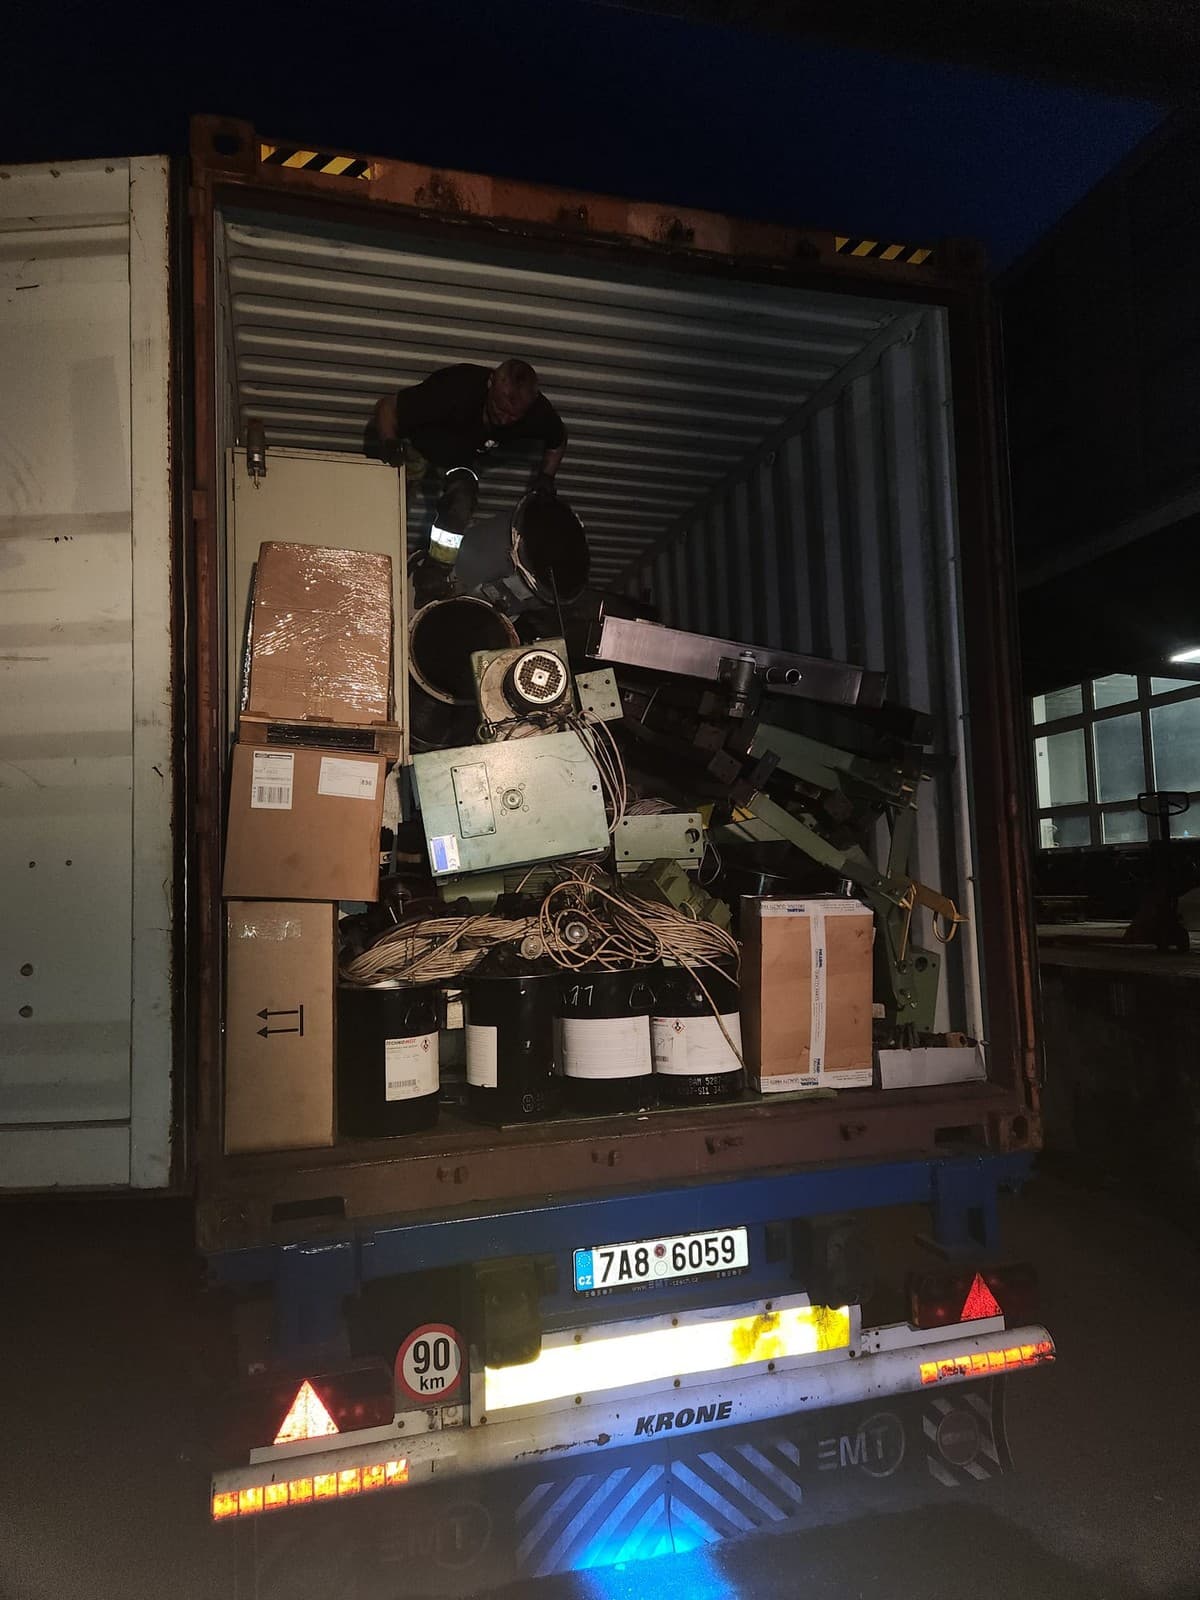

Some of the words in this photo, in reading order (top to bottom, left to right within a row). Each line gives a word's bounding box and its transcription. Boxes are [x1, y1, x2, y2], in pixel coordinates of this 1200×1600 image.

[600, 1247, 650, 1283] 7A8
[672, 1235, 736, 1271] 6059
[577, 1274, 593, 1286] CZ
[413, 1337, 450, 1374] 90
[420, 1376, 445, 1391] km
[634, 1401, 733, 1436] KRONE
[817, 1425, 888, 1471] EMT
